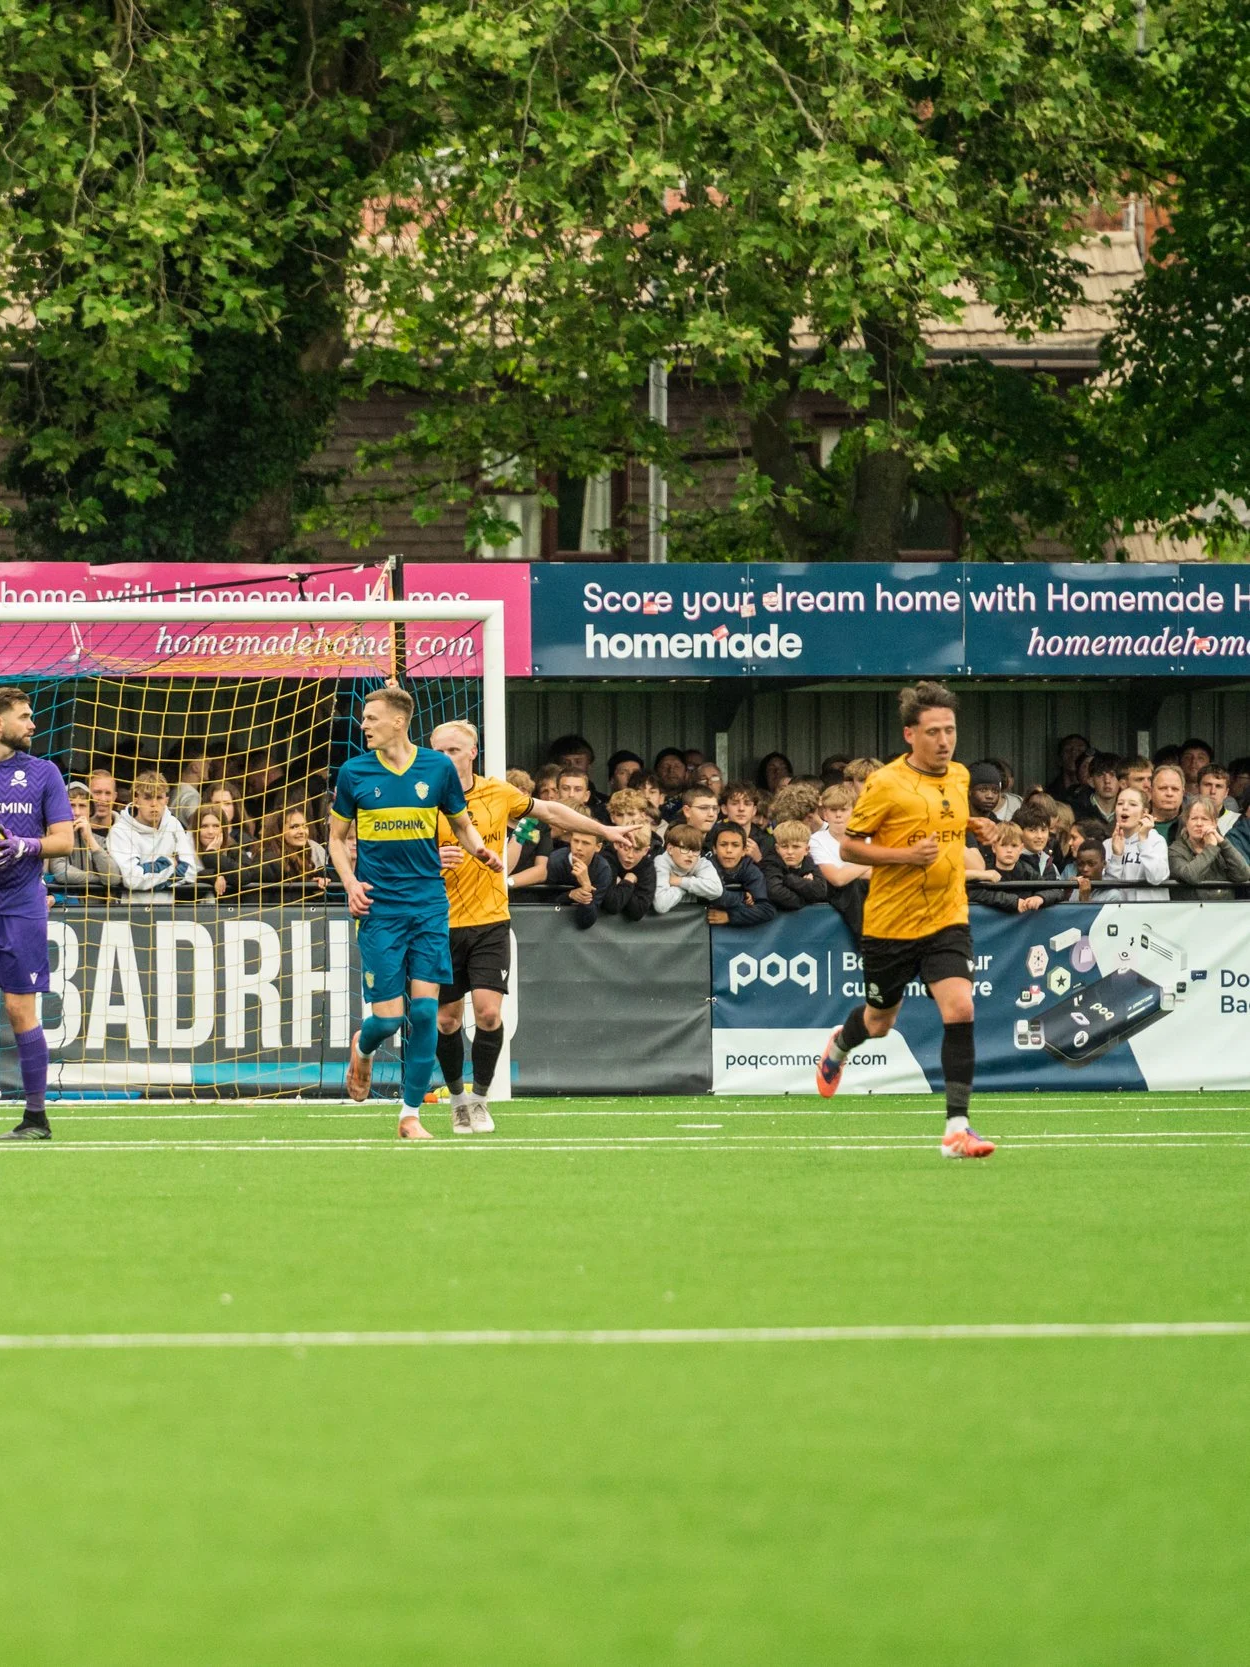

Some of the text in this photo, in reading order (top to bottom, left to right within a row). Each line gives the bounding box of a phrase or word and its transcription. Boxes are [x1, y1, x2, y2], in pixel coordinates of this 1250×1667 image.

[1, 582, 86, 602] home
[583, 583, 673, 613] Score
[682, 591, 755, 620] your
[764, 583, 865, 613] dream
[875, 583, 961, 612] home
[969, 584, 1036, 612] with
[1047, 583, 1224, 613] Homemade
[155, 626, 475, 656] homemadehome.com
[585, 624, 803, 658] homemade
[1027, 626, 1250, 657] homemadehom
[729, 951, 818, 995] poq
[726, 1053, 887, 1070] poqcomme.com
